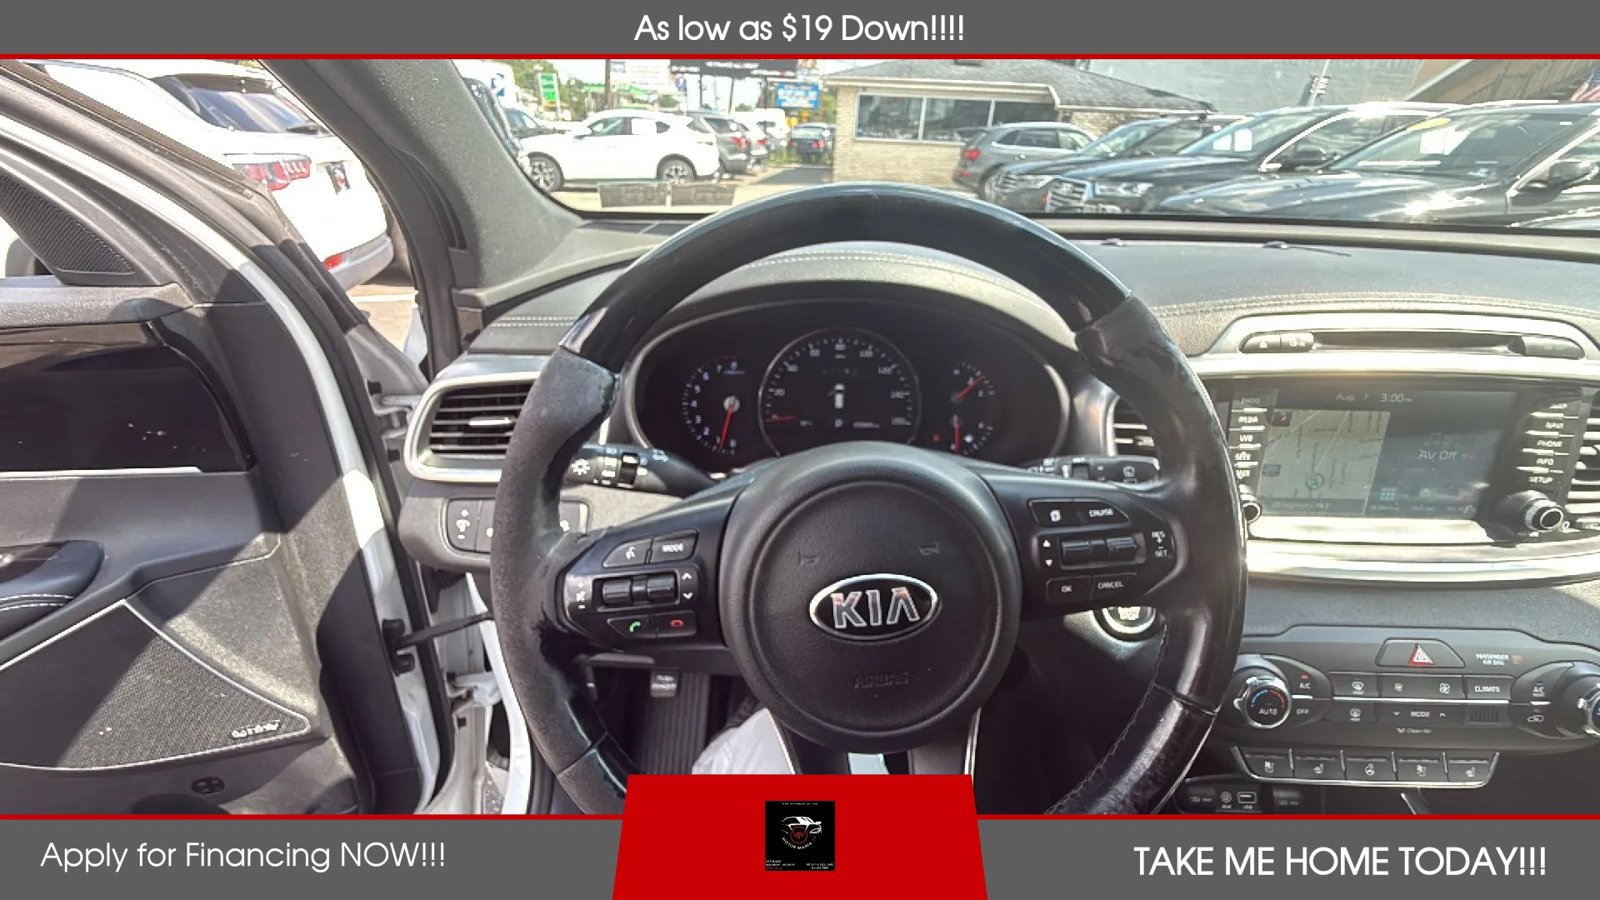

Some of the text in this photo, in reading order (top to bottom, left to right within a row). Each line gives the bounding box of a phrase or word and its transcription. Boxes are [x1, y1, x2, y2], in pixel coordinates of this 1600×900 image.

[1537, 439, 1563, 448] PHONE
[1088, 508, 1114, 518] CRUISE
[662, 542, 684, 553] MODE
[1061, 584, 1073, 593] OK
[1097, 580, 1124, 590] CANCEL
[830, 586, 921, 630] KIA
[1299, 682, 1312, 691] A/C
[1474, 684, 1502, 693] CLIMATE
[1258, 706, 1279, 716] AUTO
[1410, 710, 1431, 718] MODE
